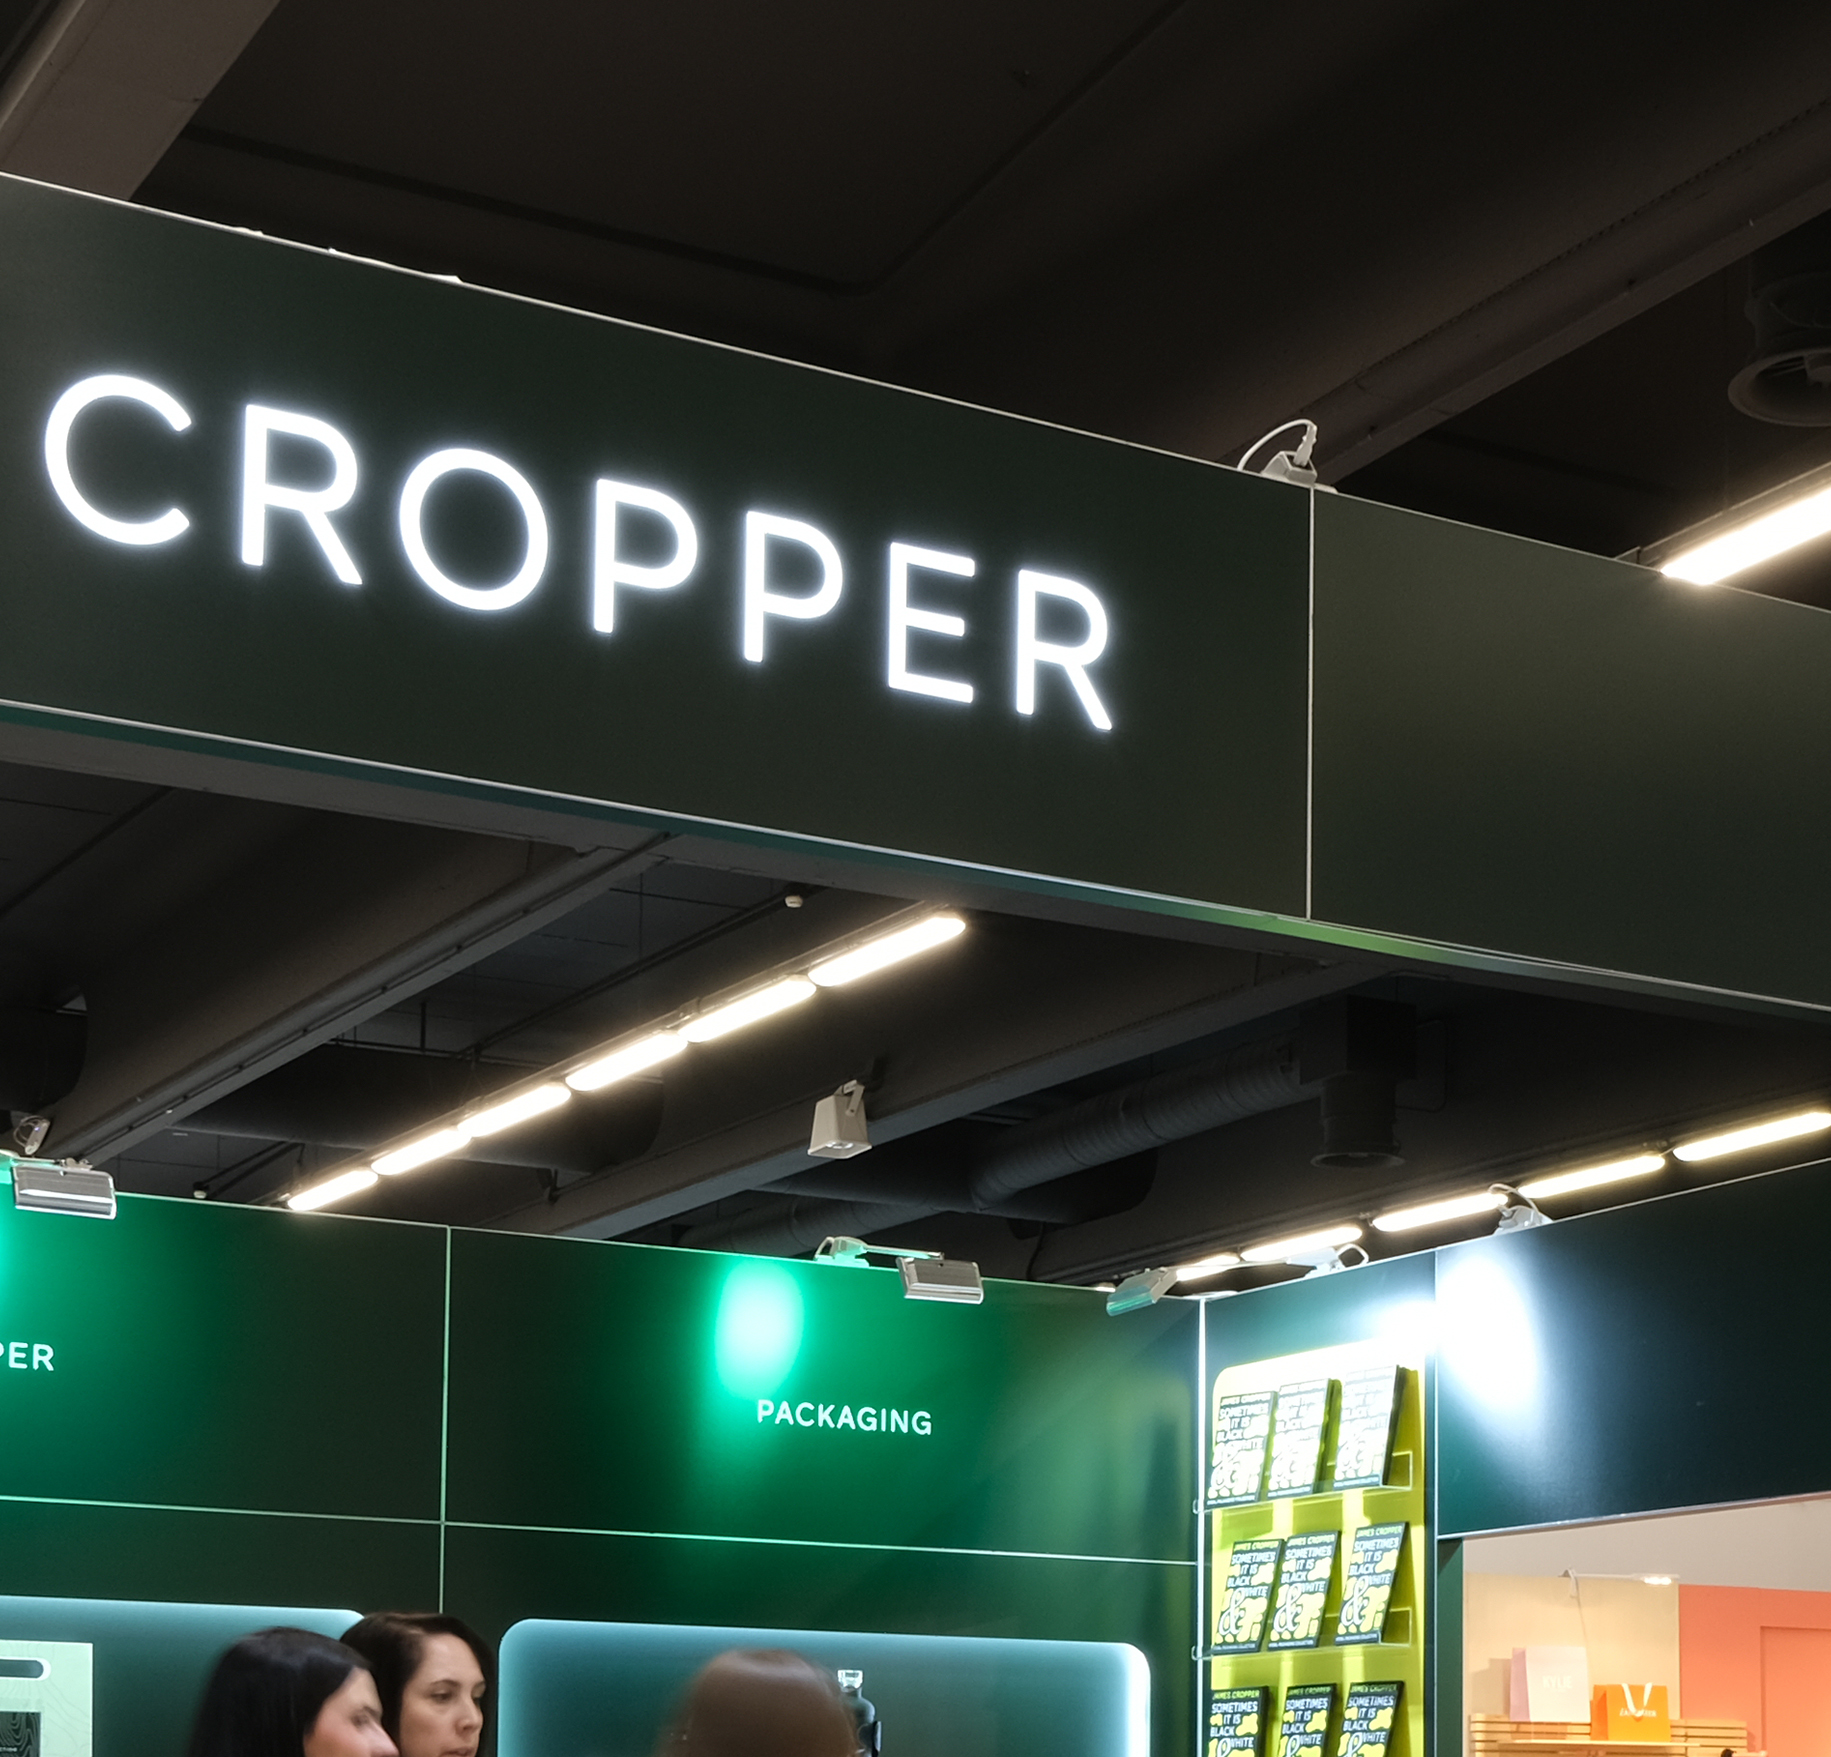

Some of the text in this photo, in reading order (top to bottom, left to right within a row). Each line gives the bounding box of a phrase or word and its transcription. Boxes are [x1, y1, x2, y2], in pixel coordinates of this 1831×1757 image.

[43, 373, 1114, 732] CROPPER
[757, 1399, 932, 1435] PACKAGING
[1354, 1538, 1399, 1551] SOMETIMES
[1231, 1551, 1275, 1564] SOMETIMES
[1285, 1546, 1332, 1559] SOMETIMES
[1364, 1550, 1382, 1562] IT IS
[1241, 1564, 1258, 1575] IT IS
[1297, 1559, 1315, 1570] IT IS
[1349, 1564, 1375, 1576] BLACK
[1226, 1576, 1251, 1587] BLACK
[1281, 1572, 1307, 1583] BLACK
[1341, 1574, 1391, 1625] & WHITE
[1218, 1586, 1267, 1634] & WHITE
[1274, 1581, 1325, 1631] & WHITE
[1542, 1675, 1572, 1689] KYLIE
[1285, 1698, 1328, 1710] SOMETIMES
[1348, 1696, 1394, 1707] SOMETIMES
[1212, 1702, 1258, 1713] SOMETIMES
[1358, 1708, 1376, 1718] IT IS
[1223, 1714, 1241, 1724] IT IS
[1295, 1711, 1312, 1721] IT IS
[1282, 1723, 1305, 1734] BLACK
[1343, 1721, 1369, 1731] BLACK
[1210, 1727, 1235, 1737] BLACK
[1362, 1732, 1386, 1742] WHITE
[1230, 1737, 1253, 1748] WHITE
[1299, 1734, 1321, 1745] WHITE
